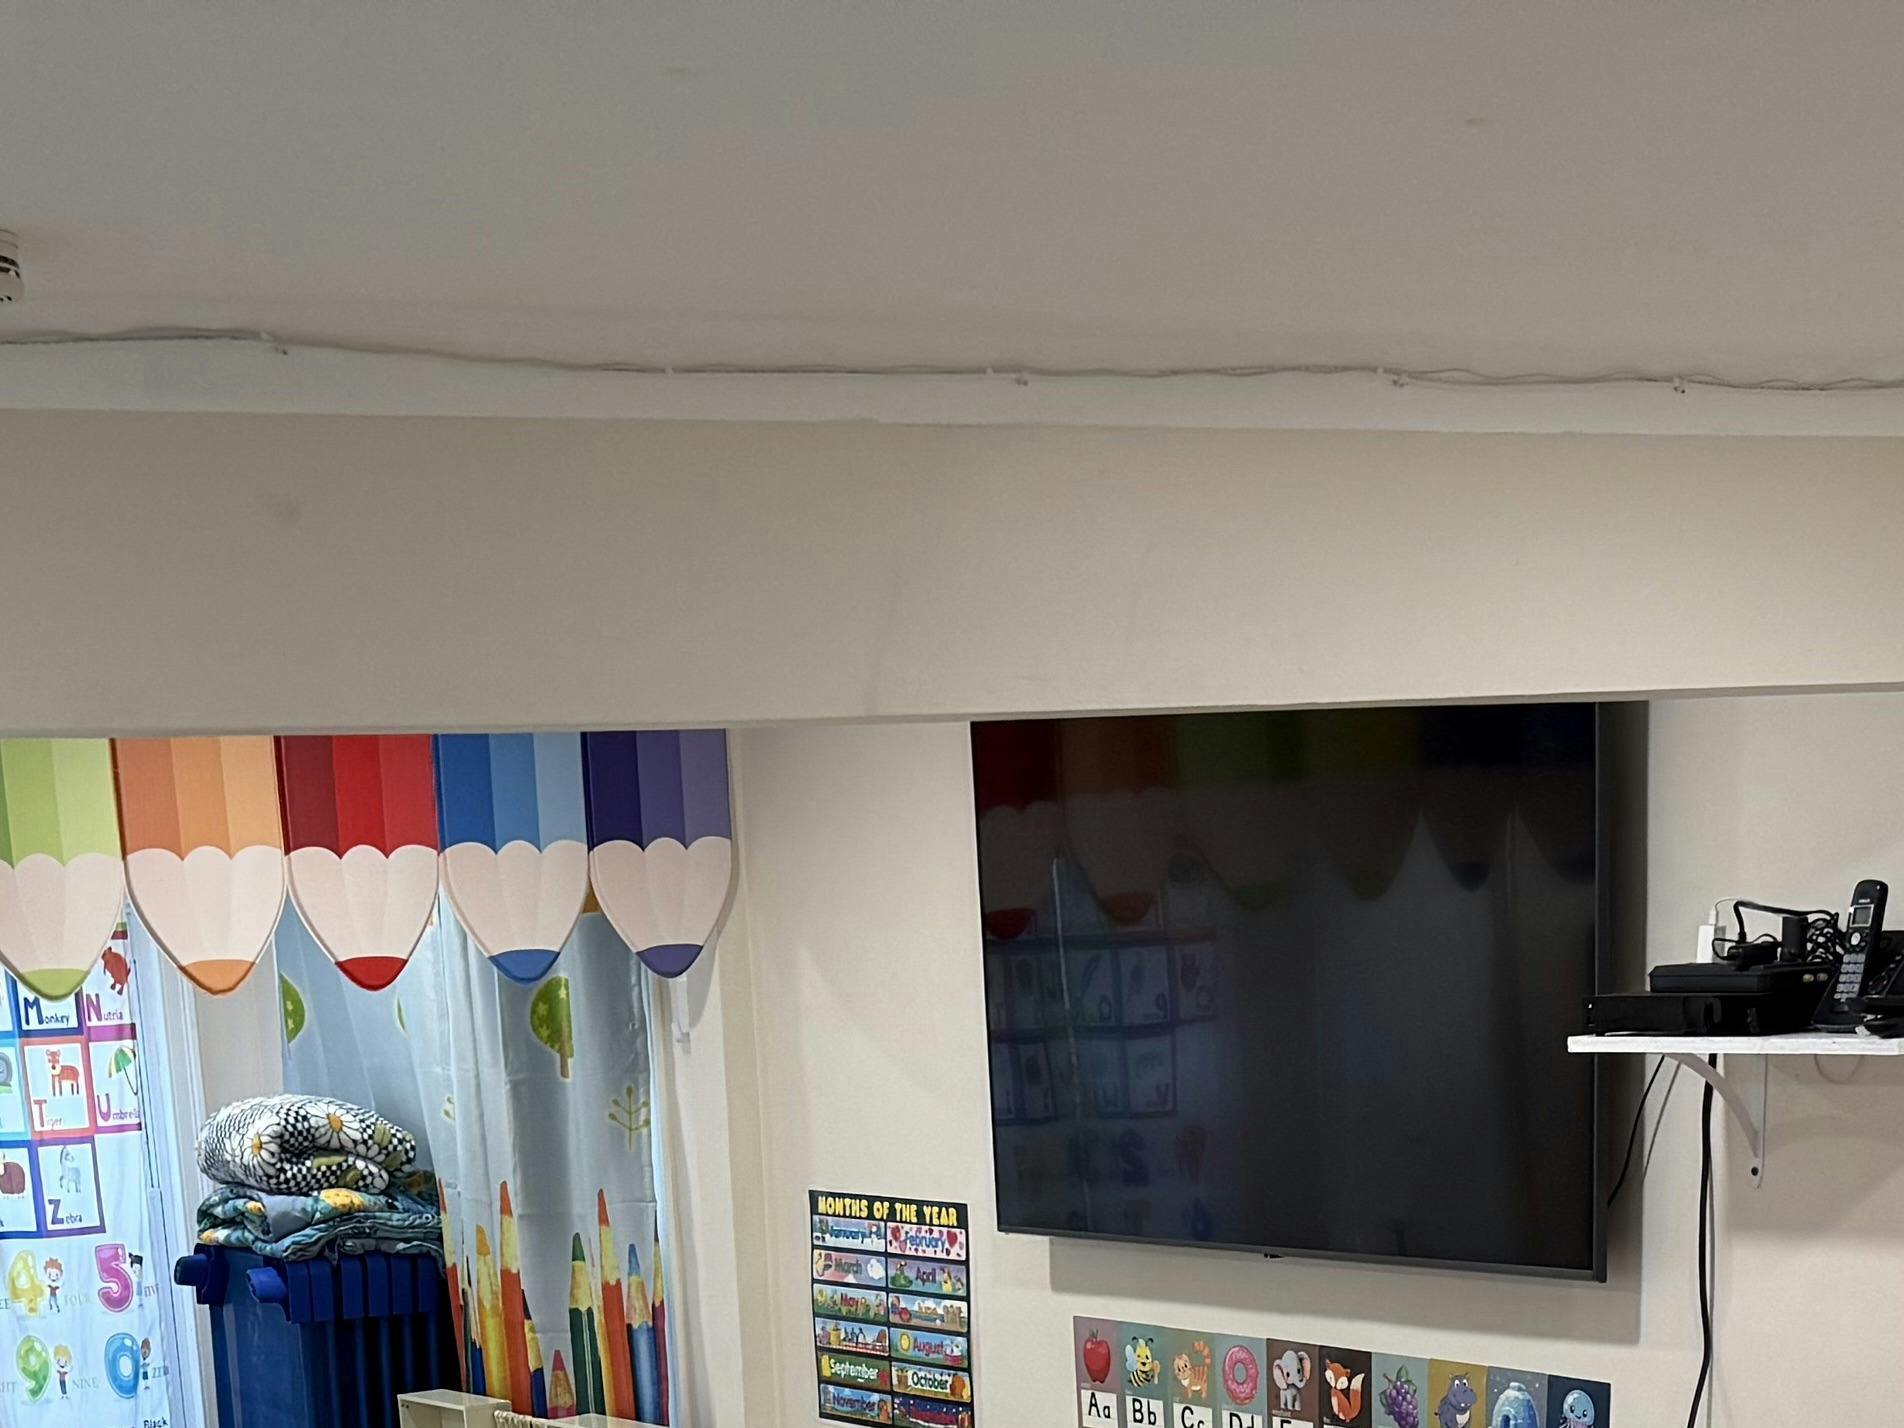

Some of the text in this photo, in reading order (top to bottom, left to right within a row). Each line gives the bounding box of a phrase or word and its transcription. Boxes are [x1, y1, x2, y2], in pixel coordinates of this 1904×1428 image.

[818, 1197, 957, 1226] MONTHS OF THE YEAR
[904, 1232, 946, 1251] February
[829, 1359, 949, 1391] September October
[1088, 1391, 1111, 1420] Aa
[1132, 1398, 1157, 1426] Bb
